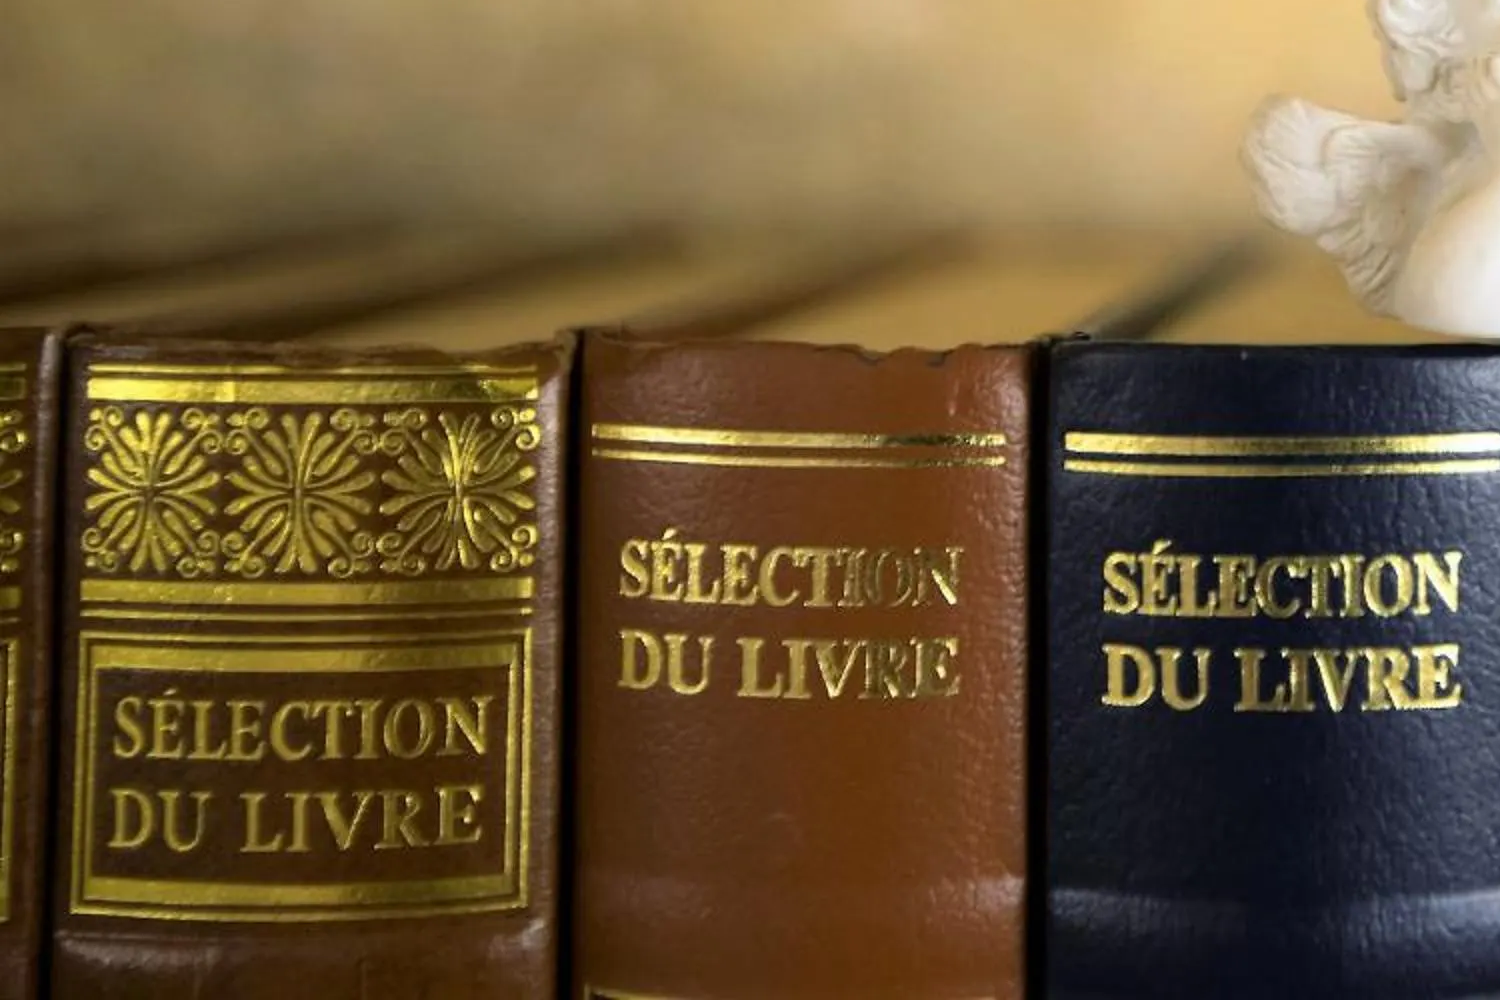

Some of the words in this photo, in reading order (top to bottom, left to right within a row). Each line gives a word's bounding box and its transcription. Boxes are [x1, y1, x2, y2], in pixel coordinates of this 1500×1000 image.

[619, 528, 964, 606] SÉLECTION
[1103, 540, 1463, 619] SÉLECTION
[617, 629, 715, 696] DU
[737, 637, 961, 698] LIVRE
[1101, 642, 1212, 711] DU
[1233, 643, 1462, 712] LIVRE
[112, 689, 494, 761] SÉLECTION
[108, 788, 213, 853] DU
[240, 784, 484, 853] LIVRE
